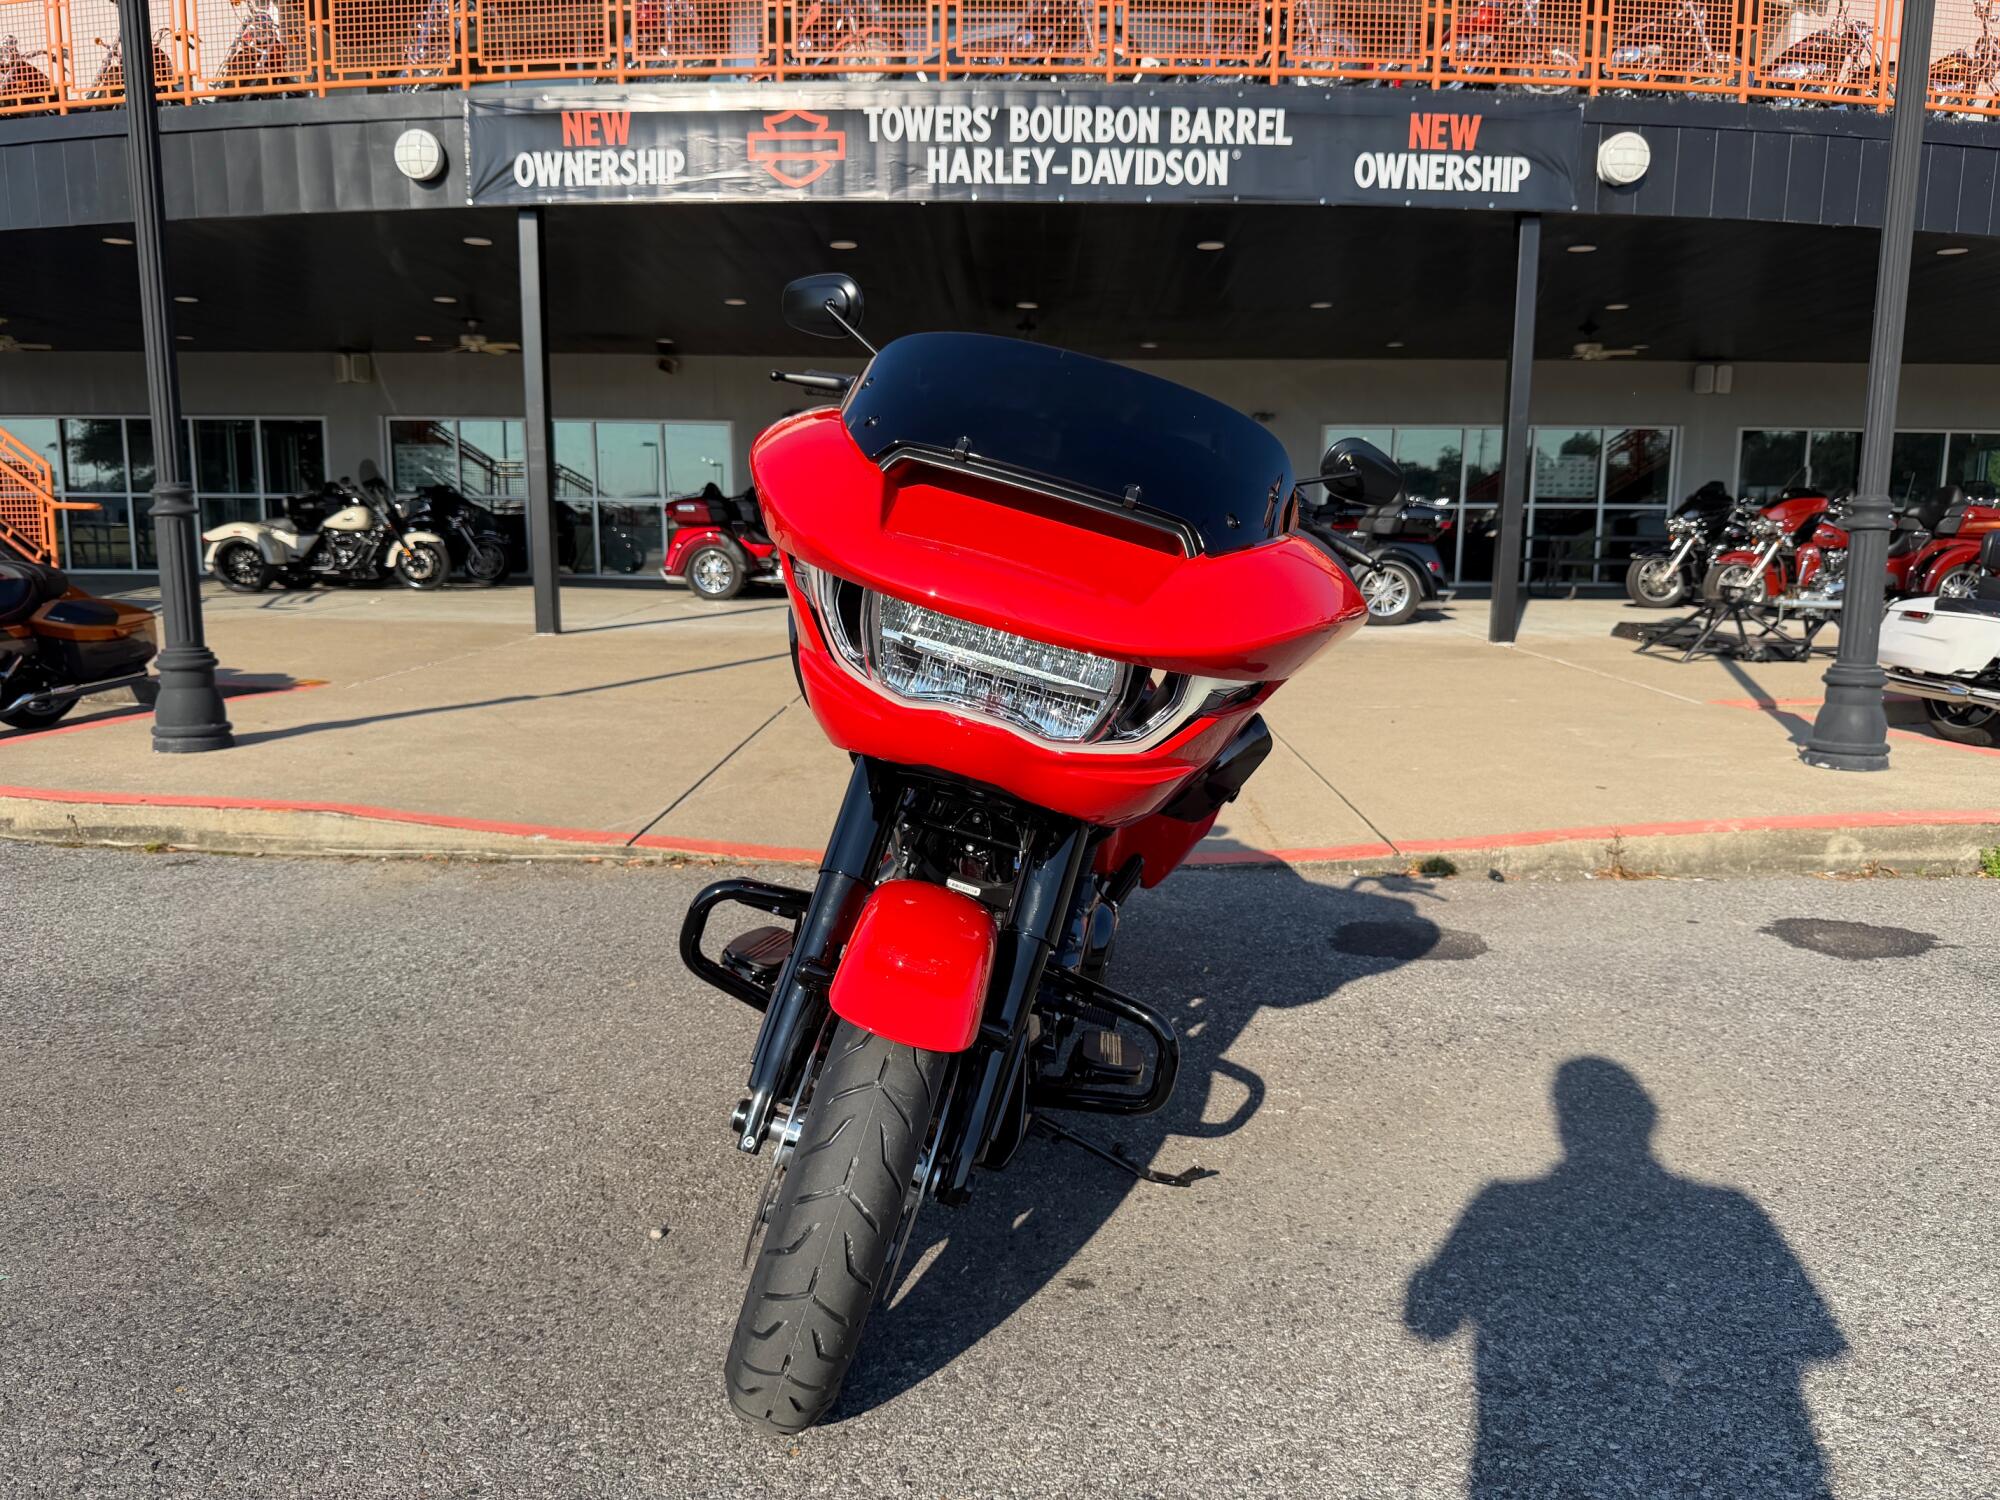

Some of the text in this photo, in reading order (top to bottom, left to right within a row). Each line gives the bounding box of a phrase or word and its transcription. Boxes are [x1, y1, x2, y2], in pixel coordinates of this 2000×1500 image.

[561, 110, 630, 146] NEW
[864, 105, 1293, 146] TOWERS' BOURBON BARREL
[1408, 112, 1482, 151] NEW
[513, 150, 685, 187] OWNERSHIP
[927, 147, 1229, 186] HARLEY-DAVIDSON
[1354, 152, 1531, 193] OWNERSHIP
